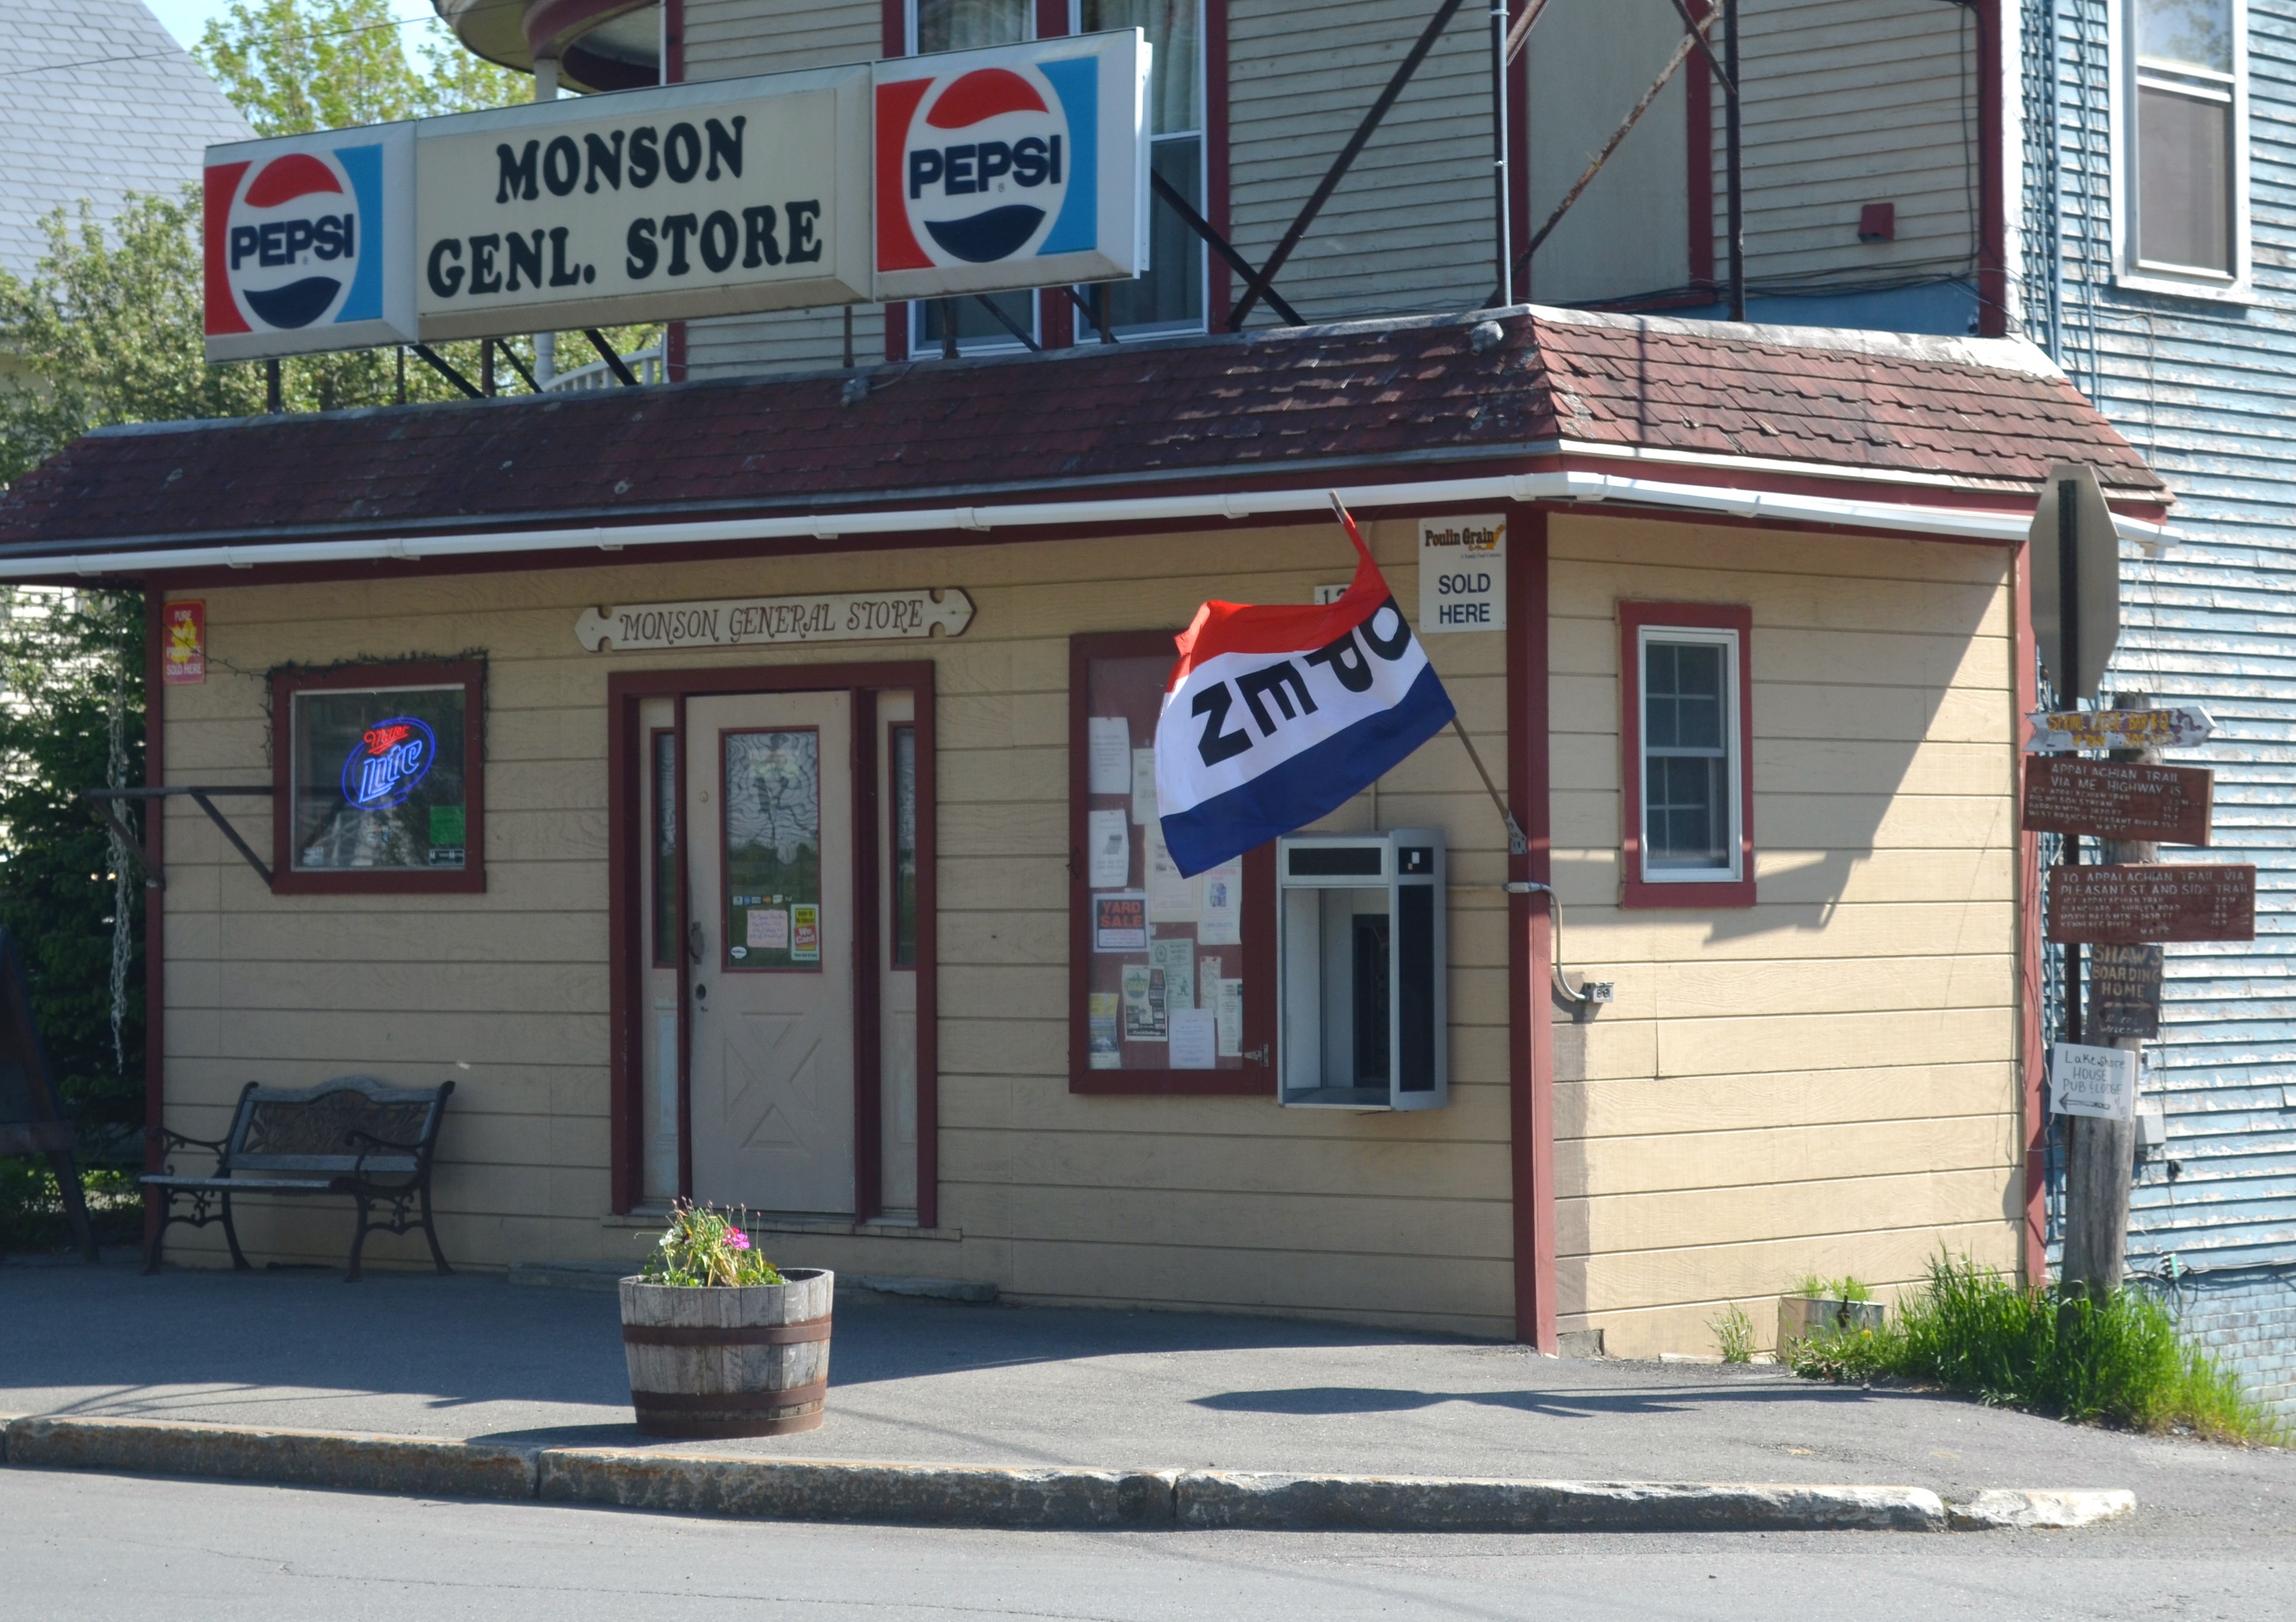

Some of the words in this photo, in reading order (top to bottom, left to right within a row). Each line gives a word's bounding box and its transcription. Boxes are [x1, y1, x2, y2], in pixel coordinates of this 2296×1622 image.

[496, 116, 747, 204] MONSON
[910, 134, 1061, 200] PEPSI
[231, 214, 354, 270] PEPSI
[427, 227, 595, 298] GENL.
[626, 200, 822, 279] STORE
[1425, 528, 1460, 547] Poulin
[1462, 527, 1494, 545] Grain
[1438, 573, 1491, 595] SOLD
[619, 610, 719, 644] MONSON
[729, 604, 836, 642] GENERAL
[846, 600, 924, 634] STORE
[1440, 603, 1490, 624] HERE
[1191, 596, 1411, 768] OPEN
[364, 725, 411, 754] Miller
[358, 740, 423, 803] Lite
[2051, 764, 2137, 780] APPALACHIAN
[2146, 771, 2180, 783] TRAIL
[2051, 777, 2070, 788] VIA
[2078, 779, 2098, 791] ME
[2107, 781, 2163, 795] HIGHWAY
[2062, 873, 2079, 883] TO
[2087, 872, 2173, 882] APPALACHIAN
[2224, 870, 2245, 880] VIA
[2061, 885, 2126, 896] PLEASANT
[2152, 884, 2177, 895] AND
[1102, 901, 1141, 914] YARD
[1100, 915, 1142, 928] SALE
[799, 927, 812, 936] We
[2092, 965, 2159, 983] BOARDING
[2102, 982, 2145, 998] HOME
[2073, 1067, 2106, 1081] HOUSE
[2063, 1078, 2086, 1092] PUB
